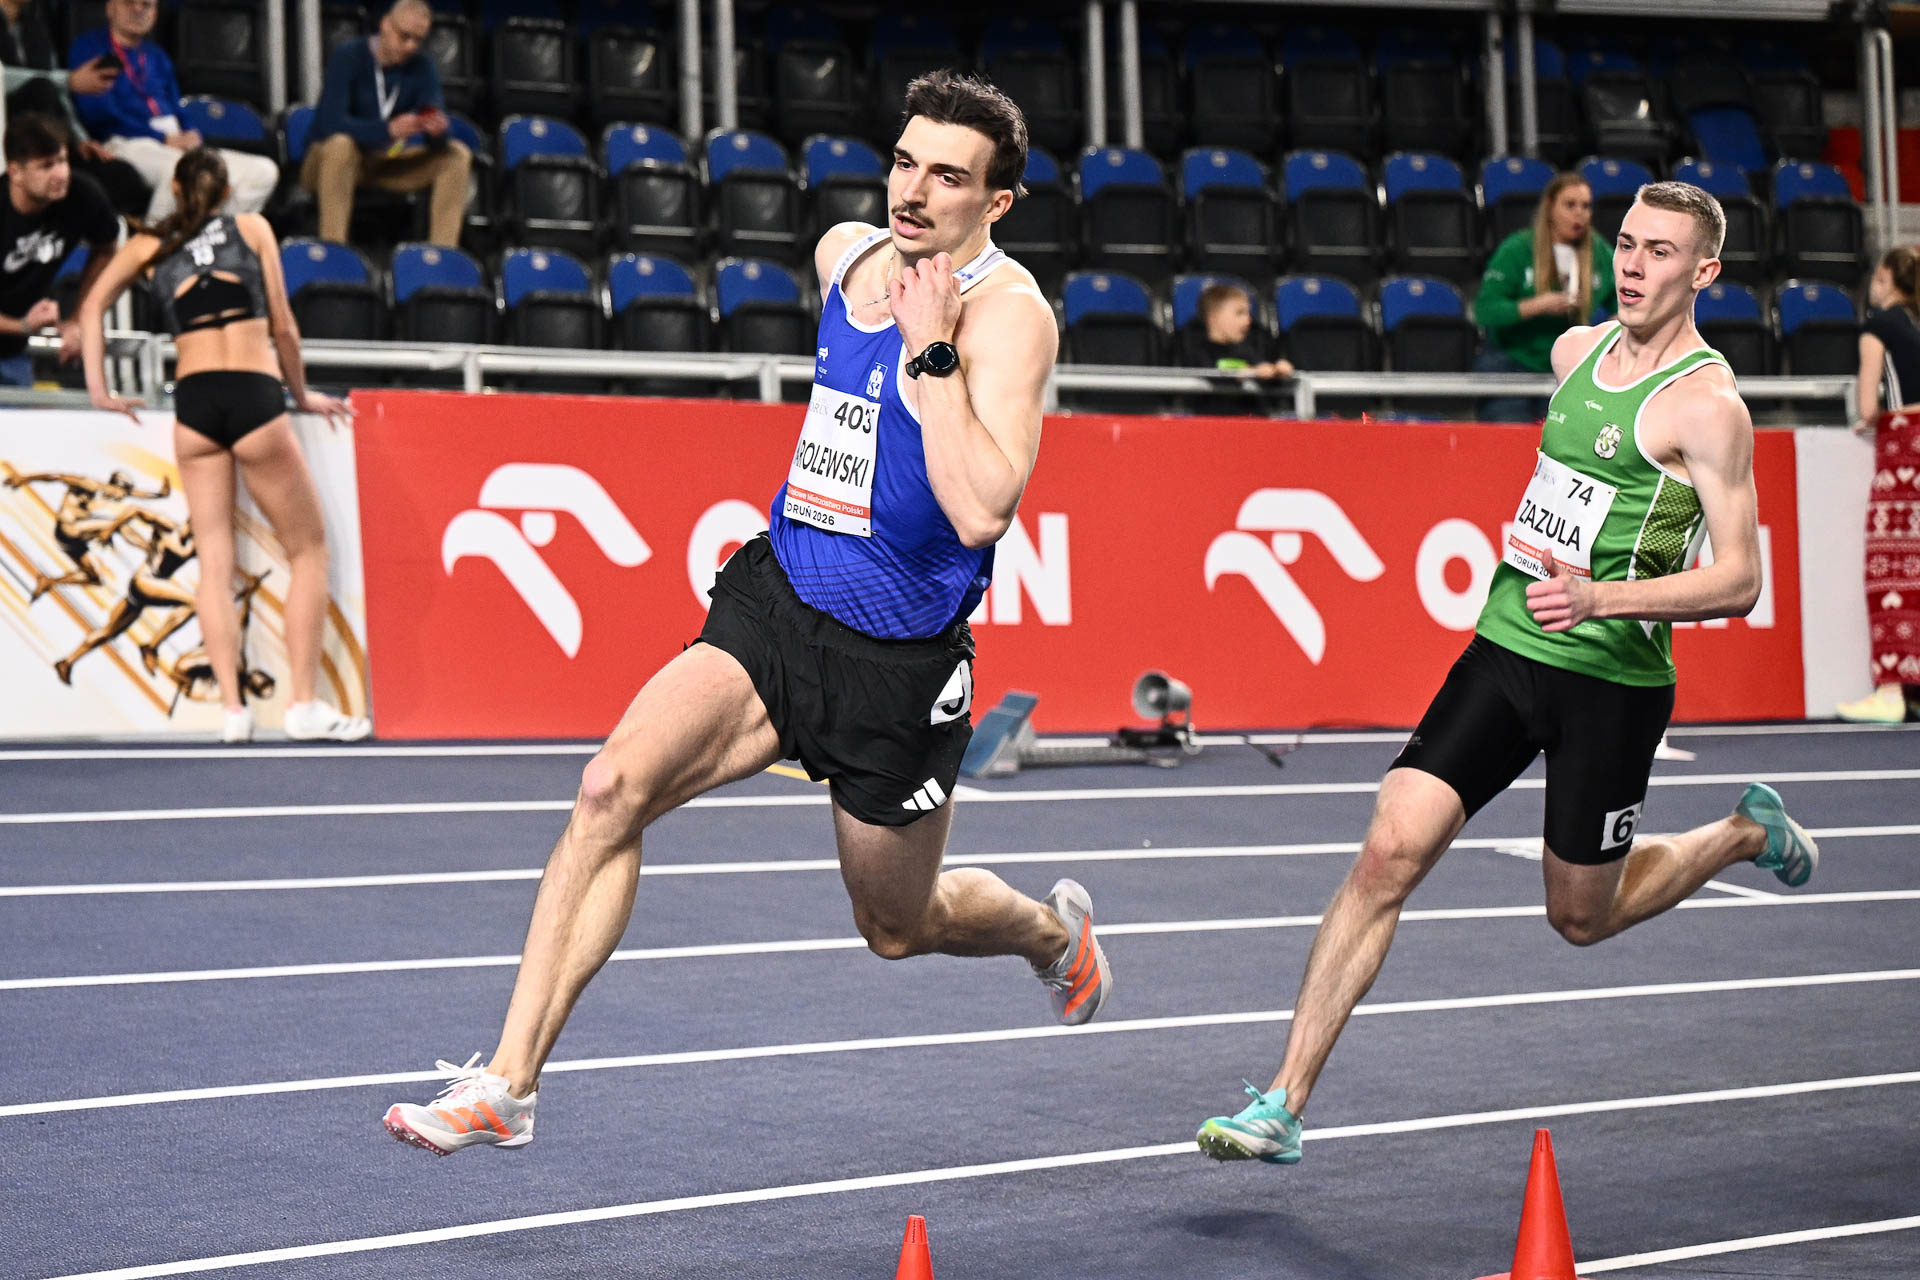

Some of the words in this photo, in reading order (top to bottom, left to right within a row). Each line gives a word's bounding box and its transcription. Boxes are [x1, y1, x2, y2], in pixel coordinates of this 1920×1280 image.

[1568, 478, 1594, 506] 74
[786, 502, 811, 519] ORUŃ
[812, 510, 835, 526] 2026
[842, 503, 864, 516] Polski
[1518, 499, 1581, 551] ZAZULA
[1612, 809, 1635, 844] 6
